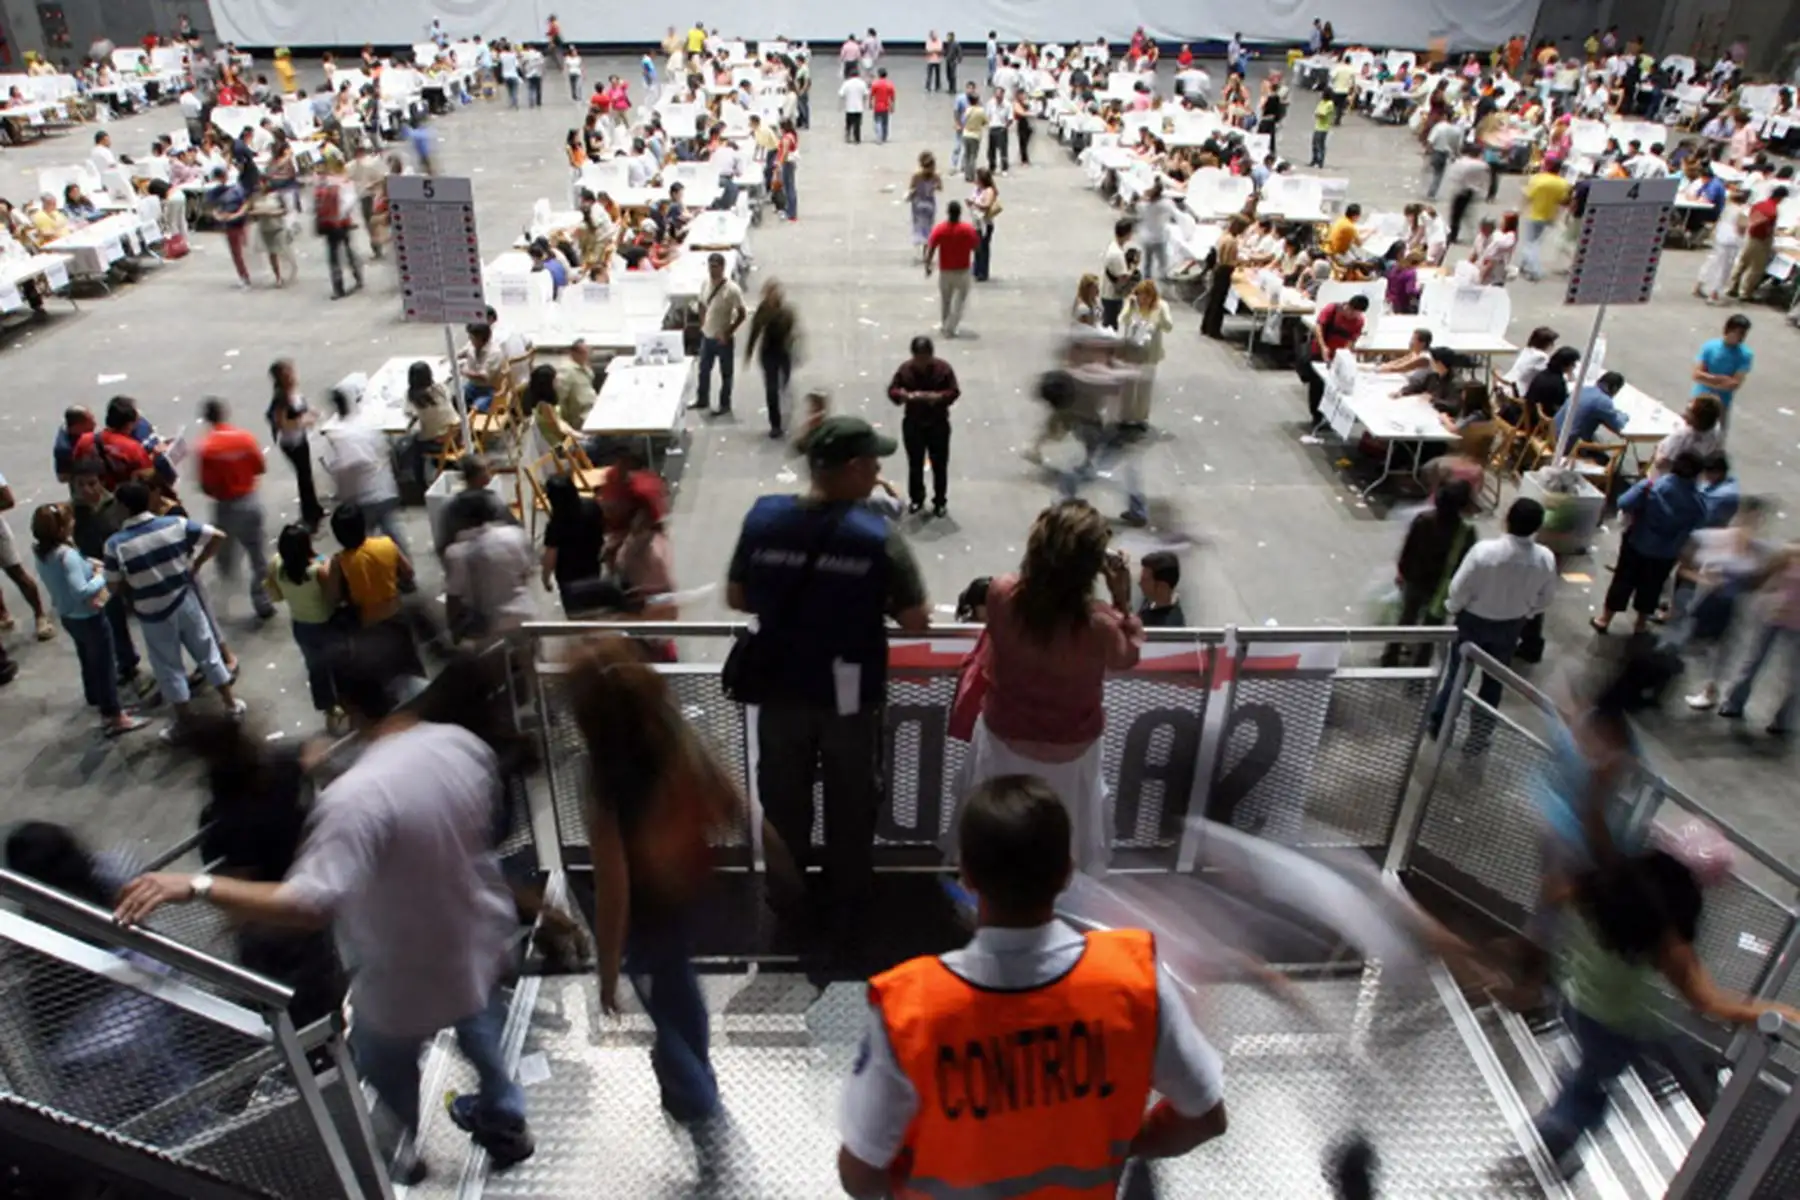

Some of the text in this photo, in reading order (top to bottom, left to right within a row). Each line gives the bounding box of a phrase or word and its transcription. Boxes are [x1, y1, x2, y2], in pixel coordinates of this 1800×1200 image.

[422, 179, 435, 199] 5
[1626, 182, 1640, 200] 4
[936, 1020, 1114, 1119] CONTROL
